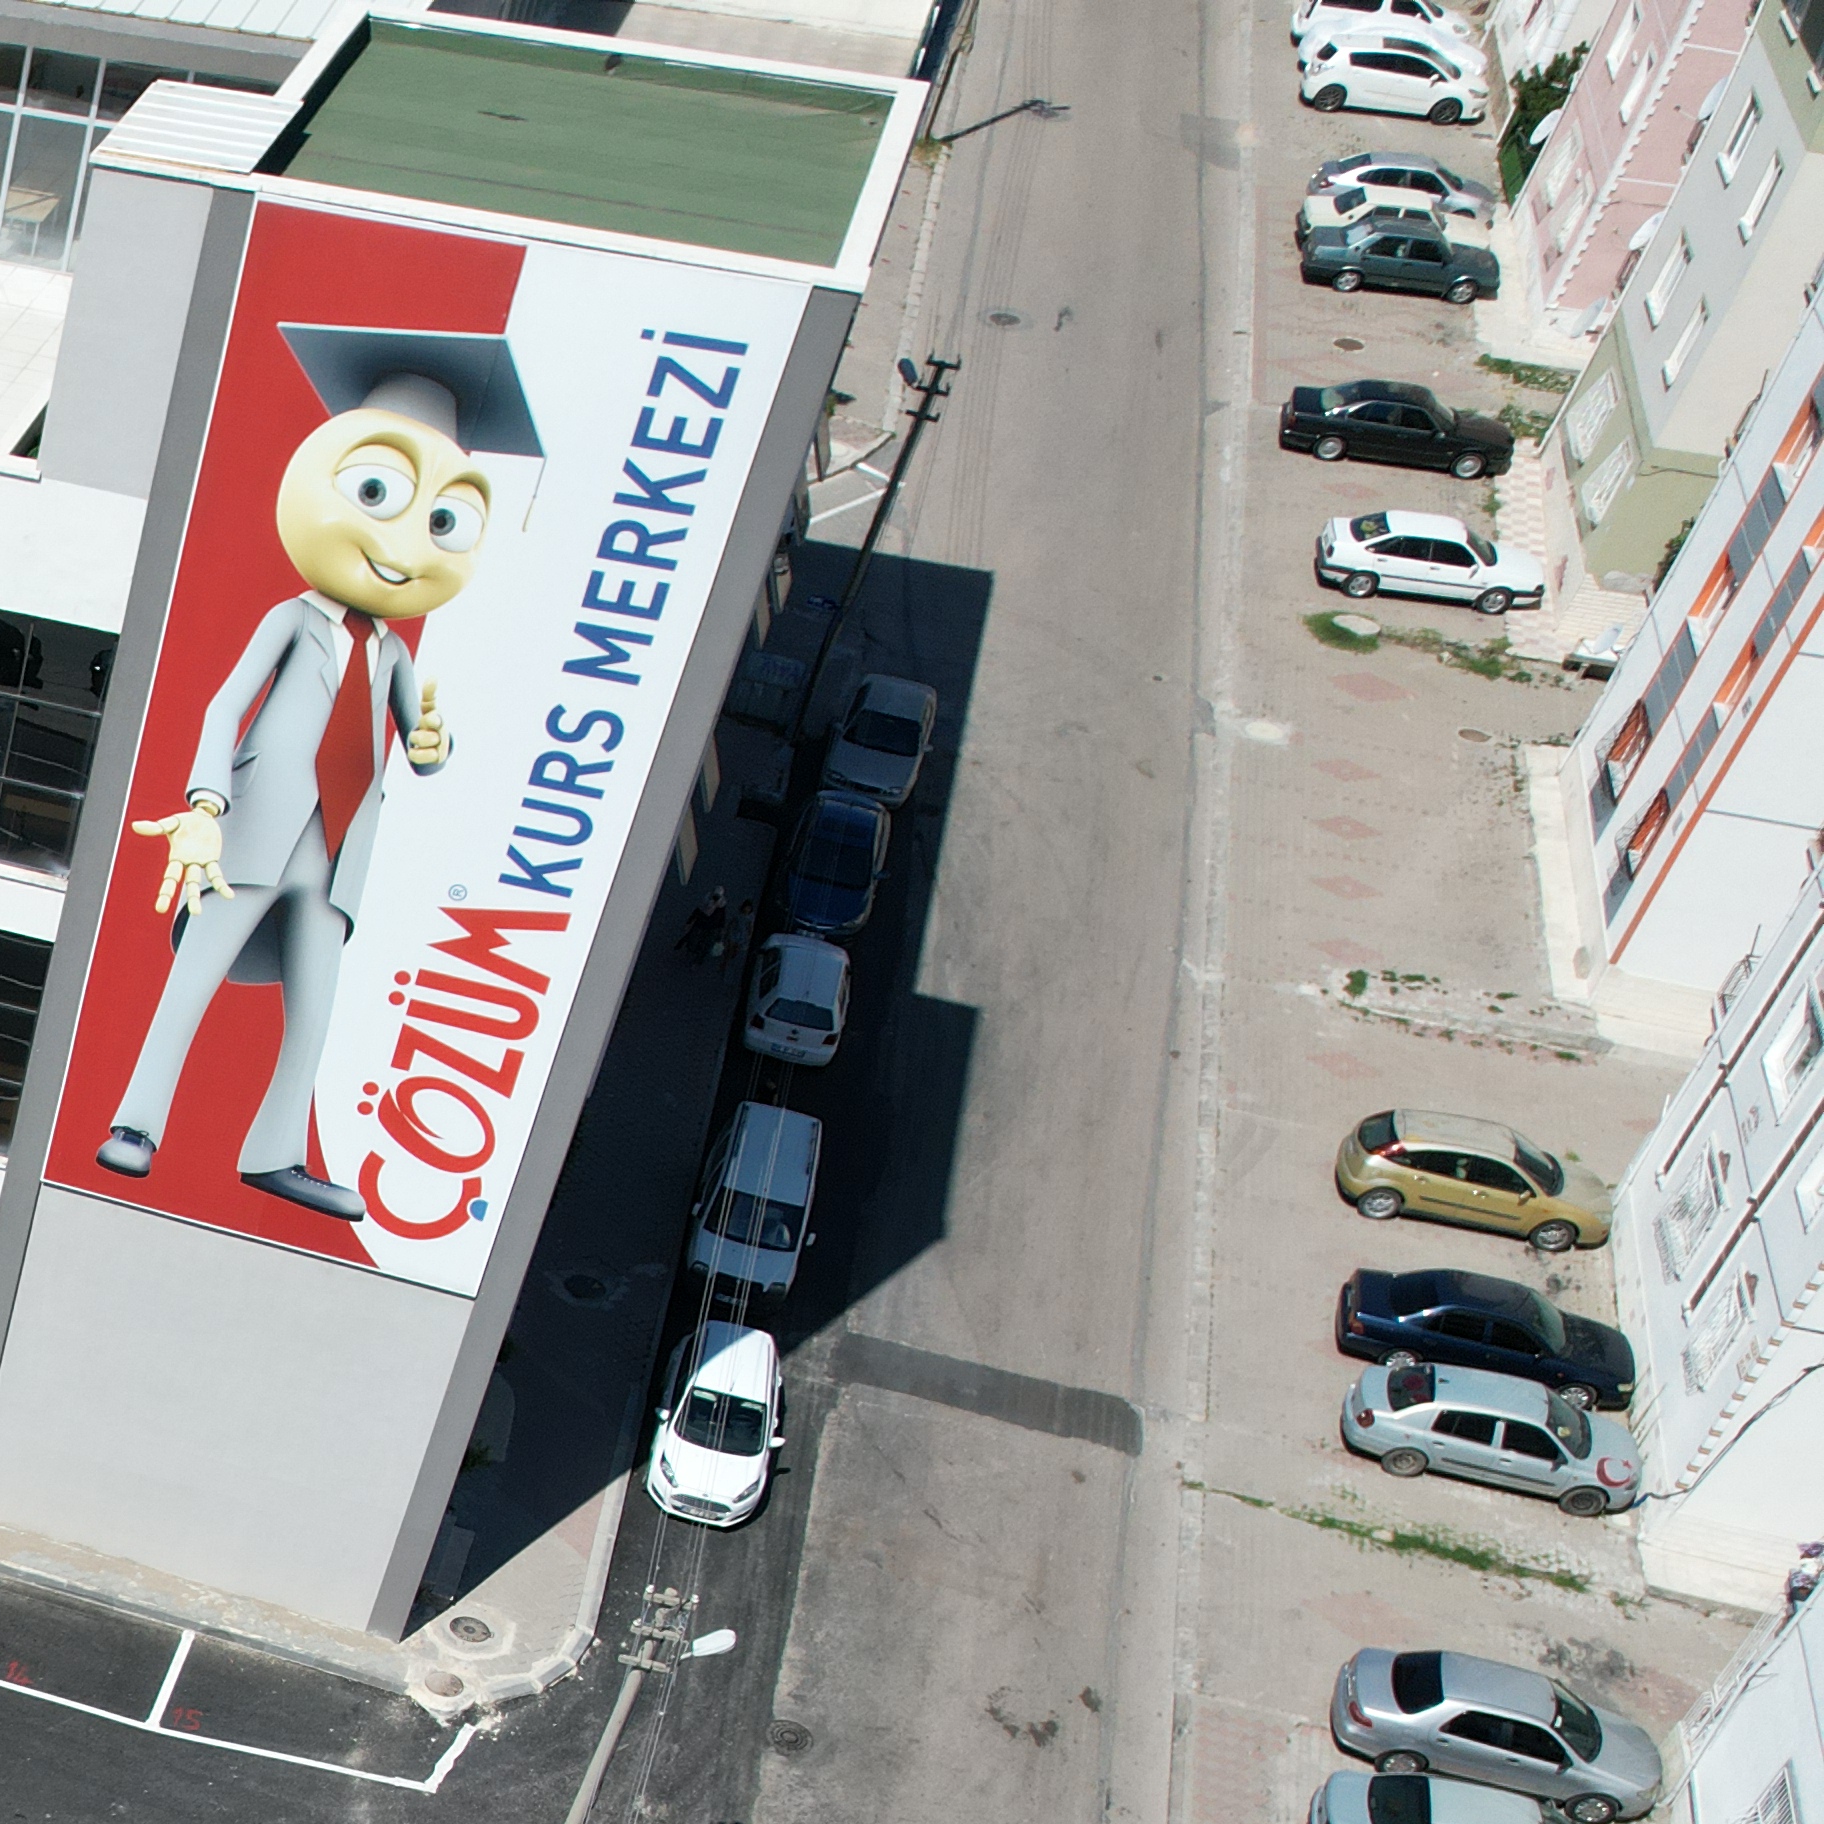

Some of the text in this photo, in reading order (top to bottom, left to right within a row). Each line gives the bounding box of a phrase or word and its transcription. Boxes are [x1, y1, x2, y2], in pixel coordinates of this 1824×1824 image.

[358, 328, 750, 1240] ÇÖZÜM KURS MERKEZİ
[171, 1706, 204, 1731] 15
